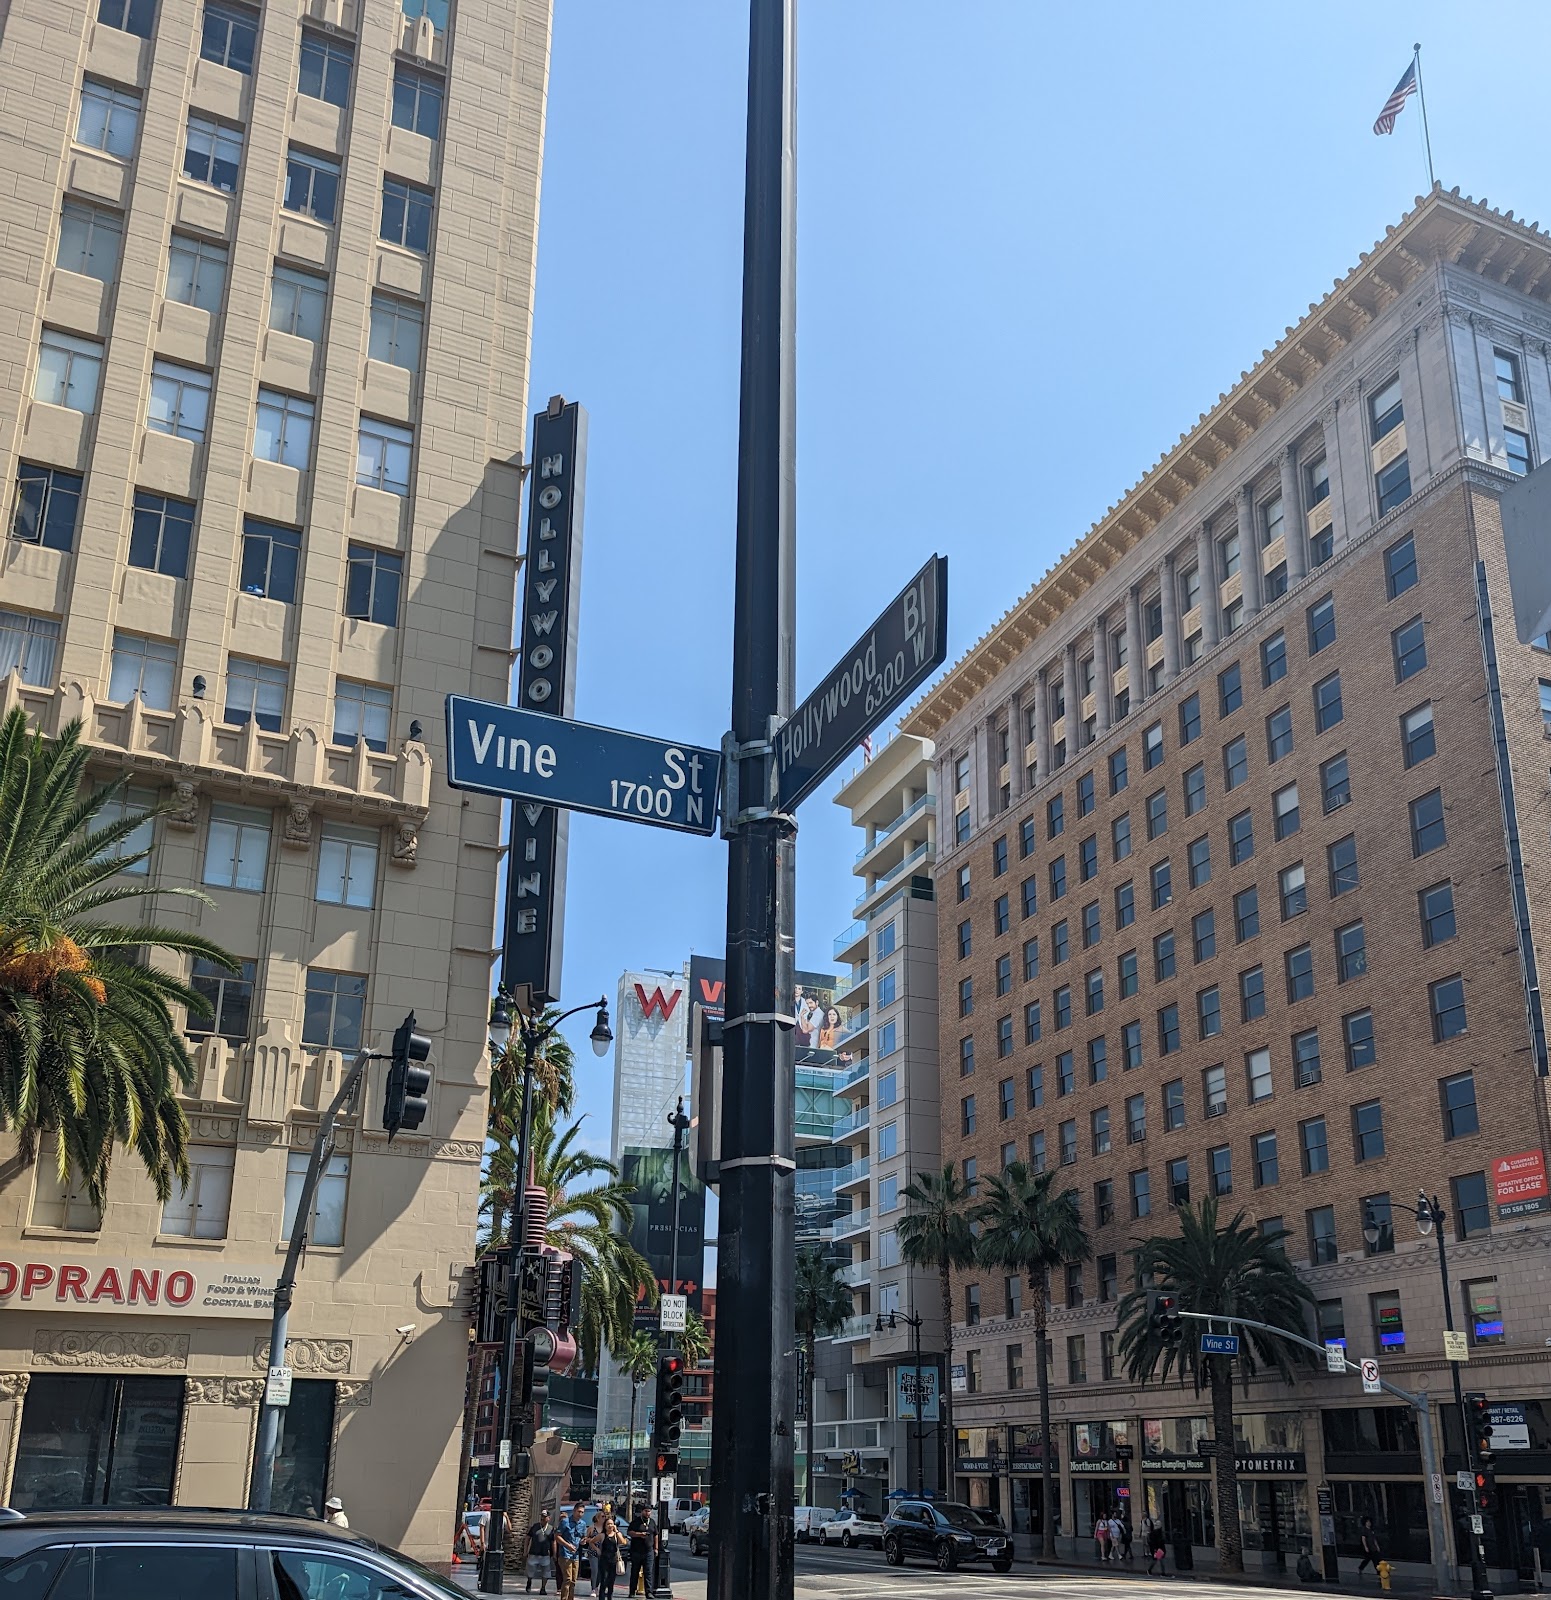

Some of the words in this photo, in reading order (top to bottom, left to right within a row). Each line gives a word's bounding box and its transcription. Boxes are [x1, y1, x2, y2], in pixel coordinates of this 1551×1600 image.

[528, 453, 564, 703] HOLLYWOO
[781, 630, 877, 774] Hollywood
[903, 577, 927, 643] Bl
[864, 650, 905, 717] 6300
[912, 625, 927, 667] W
[467, 718, 557, 779] Vine
[662, 747, 704, 794] St
[610, 779, 672, 818] 1700
[686, 793, 703, 825] N
[517, 803, 546, 935] VINE
[700, 977, 726, 1004] V
[633, 983, 683, 1022] W
[1510, 1157, 1534, 1166] CUSHMAN
[1511, 1160, 1540, 1170] WAKEFIELD
[1497, 1178, 1523, 1188] CREATIVE
[1523, 1174, 1544, 1183] OFFICE
[1497, 1186, 1515, 1196] FOR
[1515, 1181, 1542, 1193] LEASE
[1500, 1207, 1512, 1215] 310
[1512, 1205, 1524, 1213] 556
[1524, 1202, 1540, 1211] 1805
[649, 1224, 698, 1233] PRESCIAS
[223, 1274, 261, 1285] ITALIAN
[207, 1284, 236, 1295] FOOD
[236, 1286, 245, 1295] &
[246, 1286, 275, 1296] WINE
[203, 1297, 252, 1308] COCKTAIL
[663, 1299, 672, 1308] DO
[673, 1300, 685, 1309] NOT
[663, 1310, 684, 1320] BLOCK
[1206, 1338, 1223, 1349] Vine
[1225, 1340, 1235, 1350] St
[1328, 1355, 1344, 1363] BLOCK
[1490, 1415, 1524, 1424] 887-6226
[1070, 1460, 1101, 1471] Northern
[1101, 1460, 1117, 1471] Cafe
[1141, 1460, 1161, 1469] Chinese
[1162, 1460, 1186, 1471] Dumpling
[1186, 1460, 1204, 1469] House
[1235, 1459, 1296, 1471] PTOMETRIX
